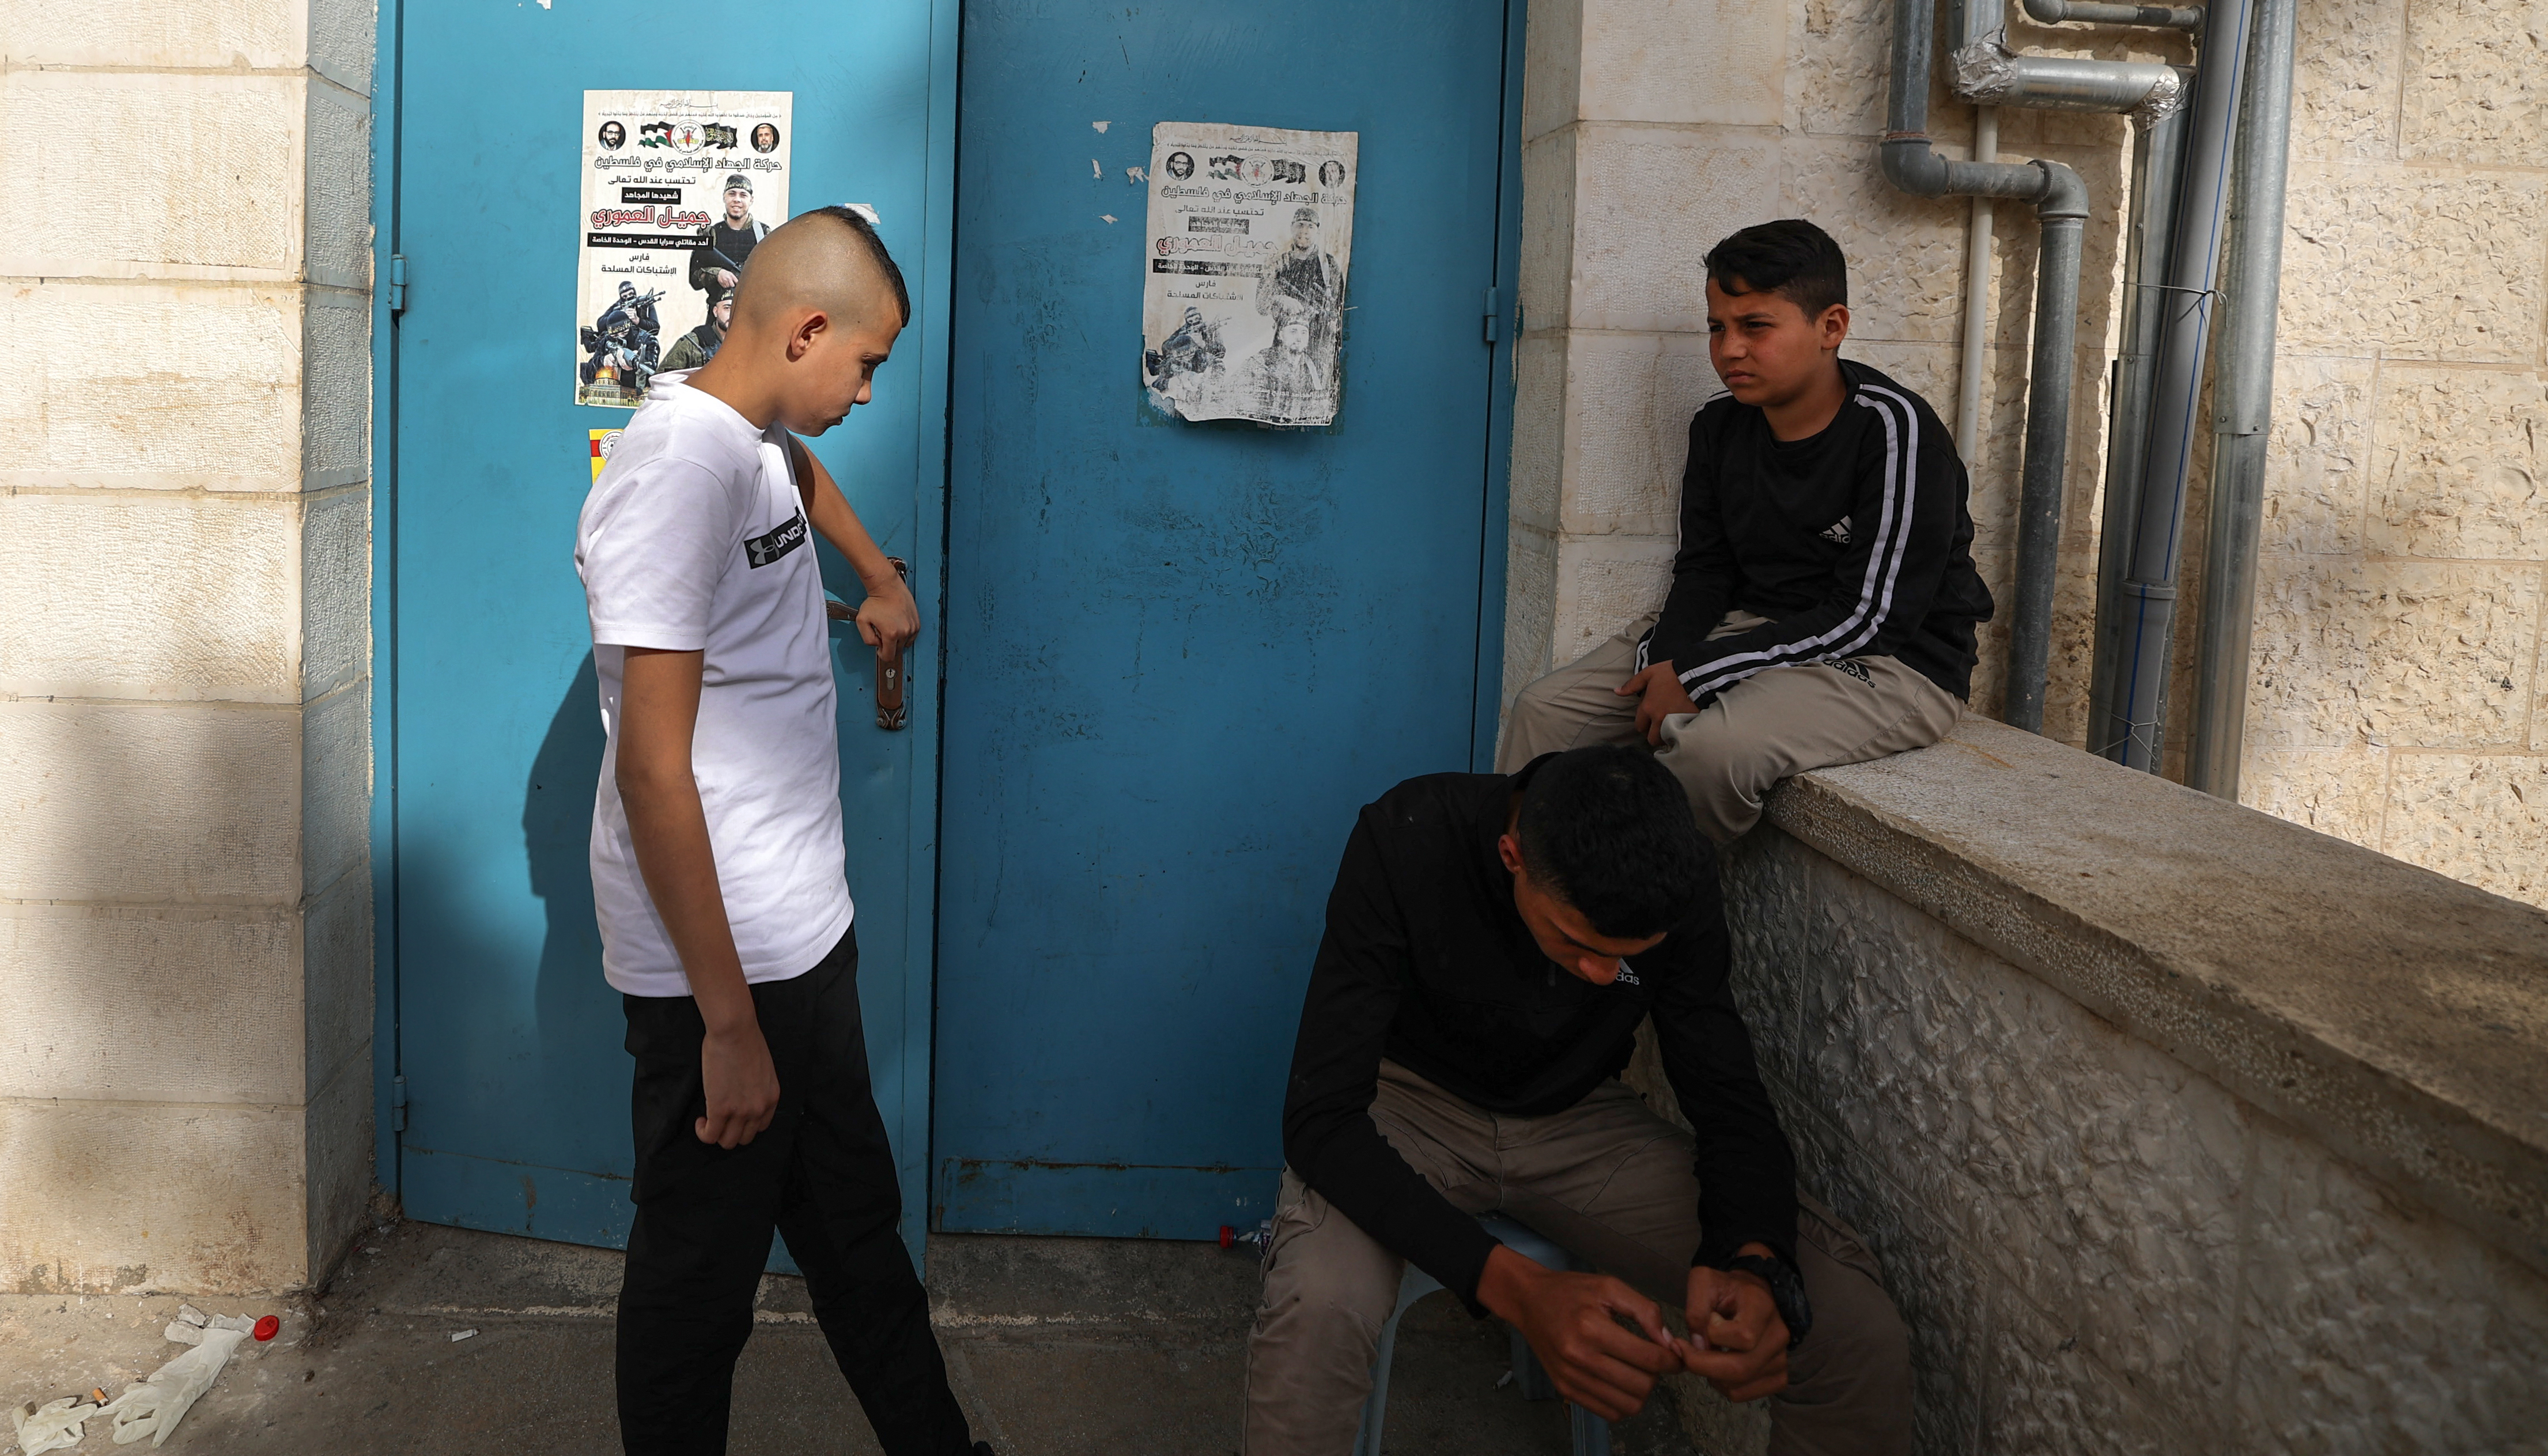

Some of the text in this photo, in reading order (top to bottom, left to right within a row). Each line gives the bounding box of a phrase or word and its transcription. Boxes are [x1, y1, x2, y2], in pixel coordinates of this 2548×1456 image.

[595, 156, 782, 173] حركة الجهاد الإسلامي في فلسطين
[608, 175, 631, 184] تعالى
[649, 176, 663, 184] عند
[665, 177, 696, 186] تحتسب
[624, 191, 678, 201] شهيدها المجاهد
[1161, 186, 1209, 198] فلسطين
[1212, 188, 1231, 202] في
[1234, 190, 1281, 205] الإسلامي
[1284, 191, 1318, 206] الجهاد
[1233, 207, 1264, 217] تحتسب
[591, 205, 711, 229] جميل العموري
[613, 237, 632, 245] الوحدة
[638, 237, 658, 245] القدس
[659, 238, 674, 247] سرايا
[675, 239, 696, 248] مقاتلي
[697, 237, 709, 245] أحد
[1156, 234, 1222, 256] العموري
[629, 254, 649, 262] فارس
[601, 264, 634, 274] المسلحة
[1196, 280, 1216, 288] فارس
[1167, 290, 1201, 299] المسلحة
[1819, 532, 1851, 544] adid
